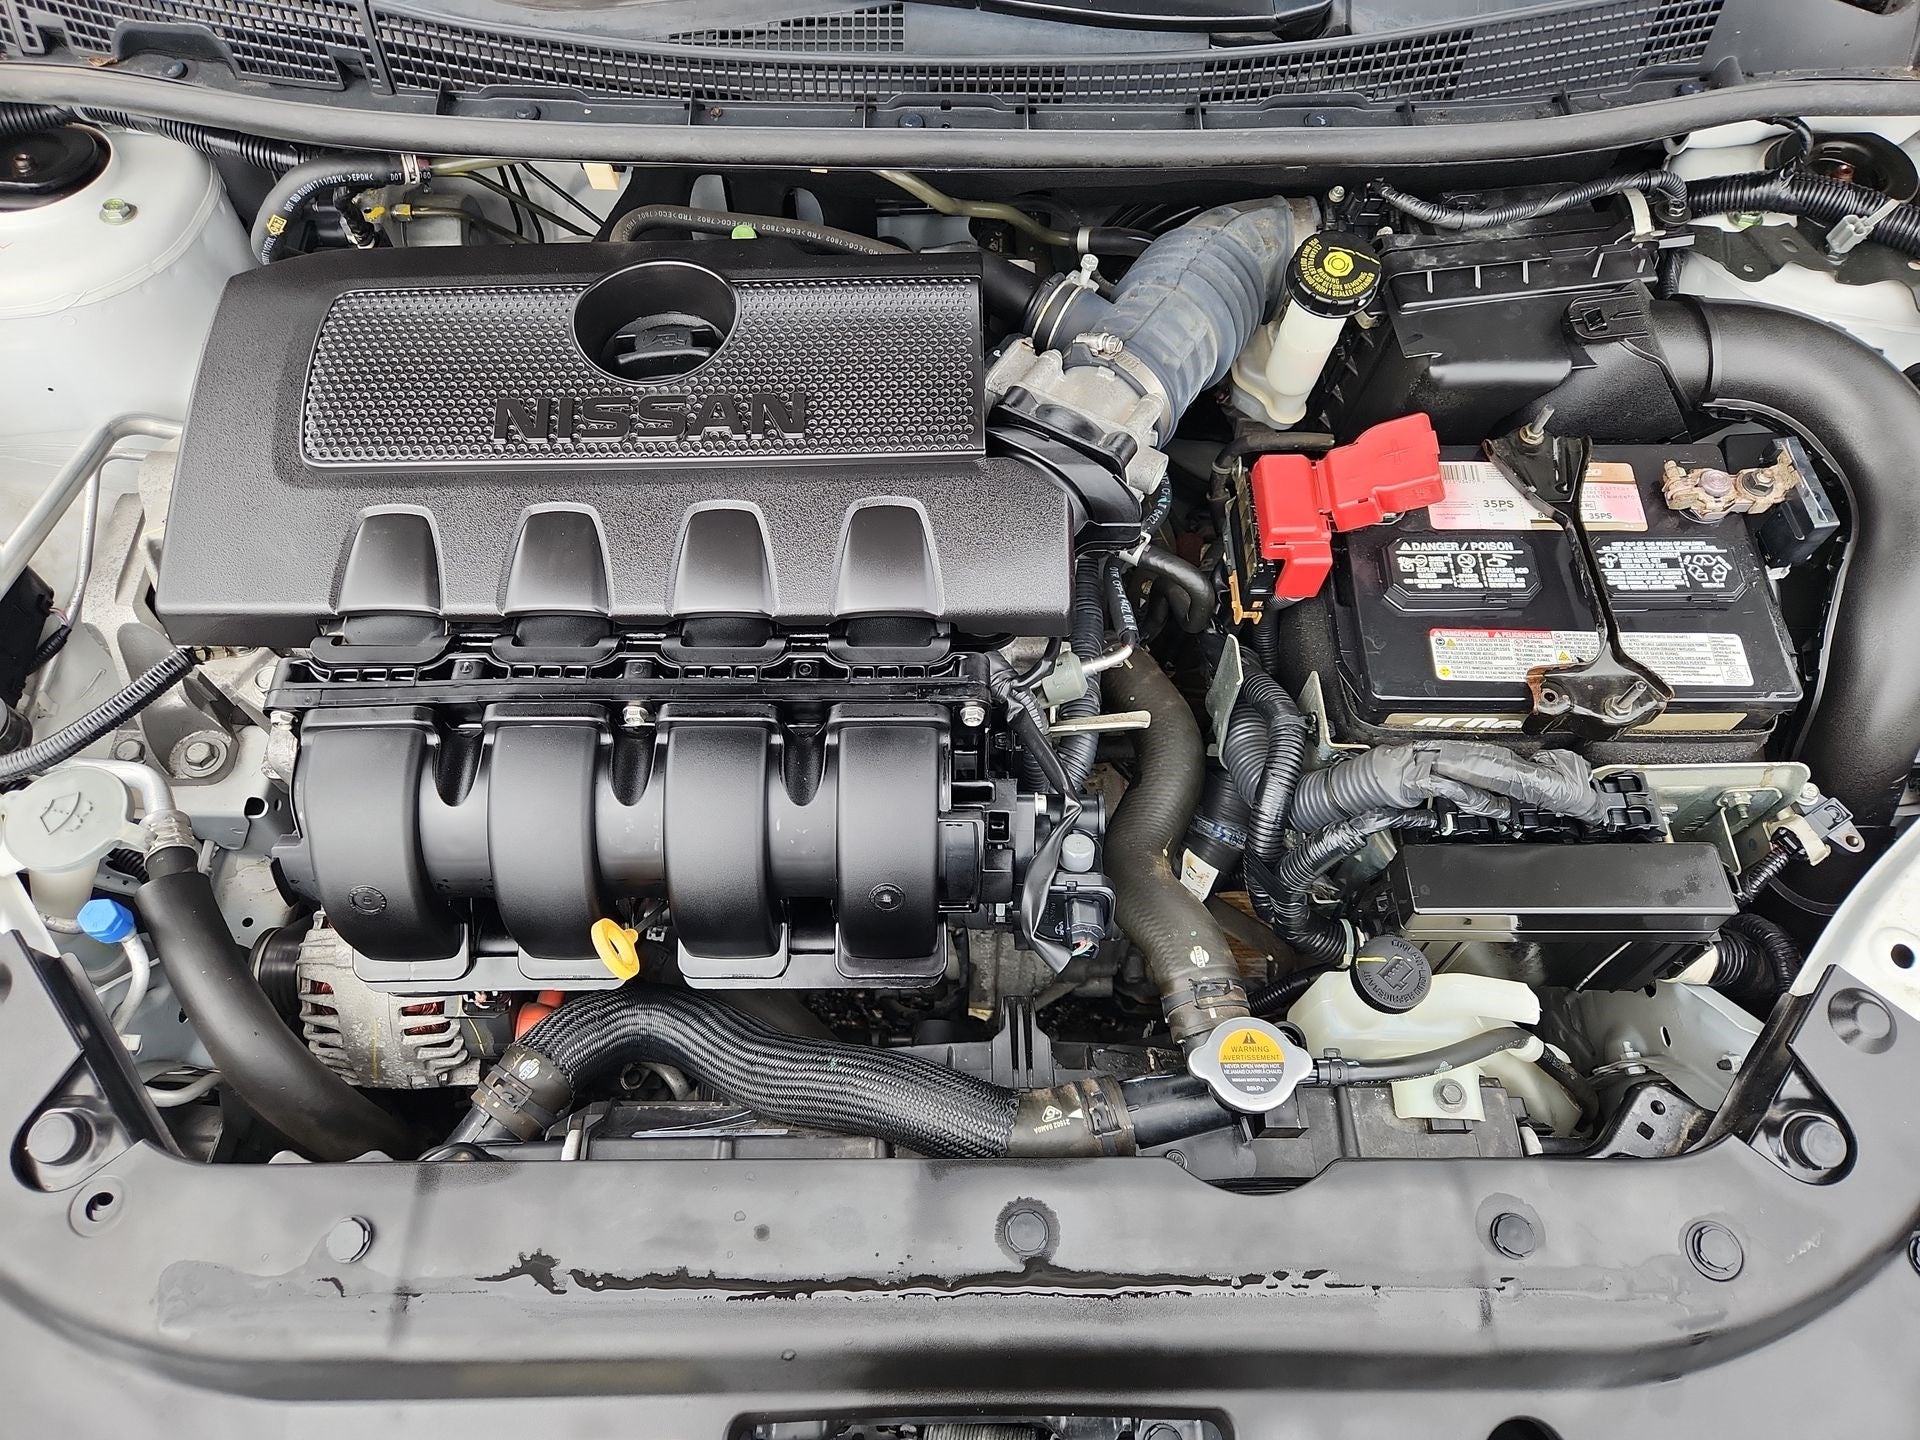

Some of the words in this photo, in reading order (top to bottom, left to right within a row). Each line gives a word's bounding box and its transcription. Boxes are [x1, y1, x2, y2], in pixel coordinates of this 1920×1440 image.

[390, 172, 402, 181] DOT
[1308, 244, 1322, 258] CLEAN
[1313, 274, 1323, 284] CAP
[1317, 267, 1340, 284] WARNING
[1313, 282, 1327, 295] FROM
[1332, 289, 1353, 297] SEALED
[1321, 280, 1344, 290] BEFORE
[494, 393, 805, 443] NISSAN
[1483, 499, 1514, 509] 35PS
[1589, 512, 1613, 520] 35PS
[1411, 542, 1459, 550] DANGER
[1460, 542, 1468, 550] /
[1470, 542, 1514, 550] POISON
